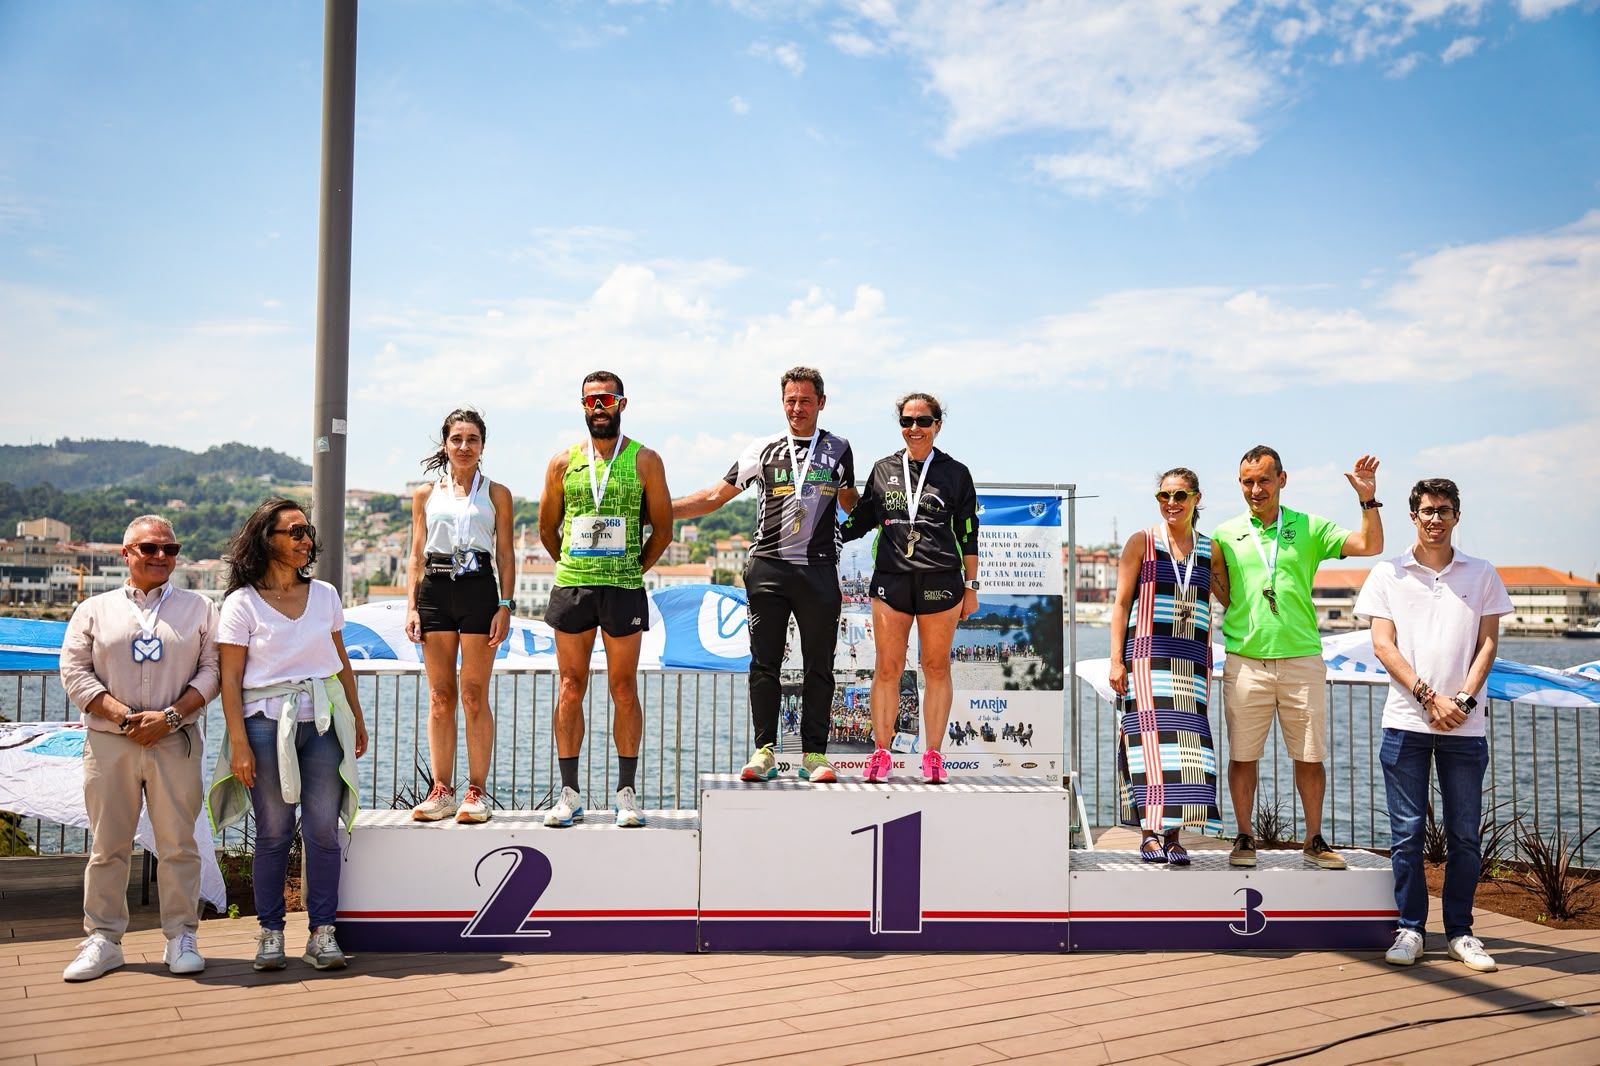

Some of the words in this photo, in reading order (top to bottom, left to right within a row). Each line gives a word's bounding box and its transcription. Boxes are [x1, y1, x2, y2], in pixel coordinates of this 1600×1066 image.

[775, 467, 787, 482] LA
[604, 518, 621, 527] 368
[979, 531, 1018, 539] ARREIRA
[851, 810, 922, 935] 1
[460, 845, 552, 938] 2
[1229, 888, 1267, 936] 3
